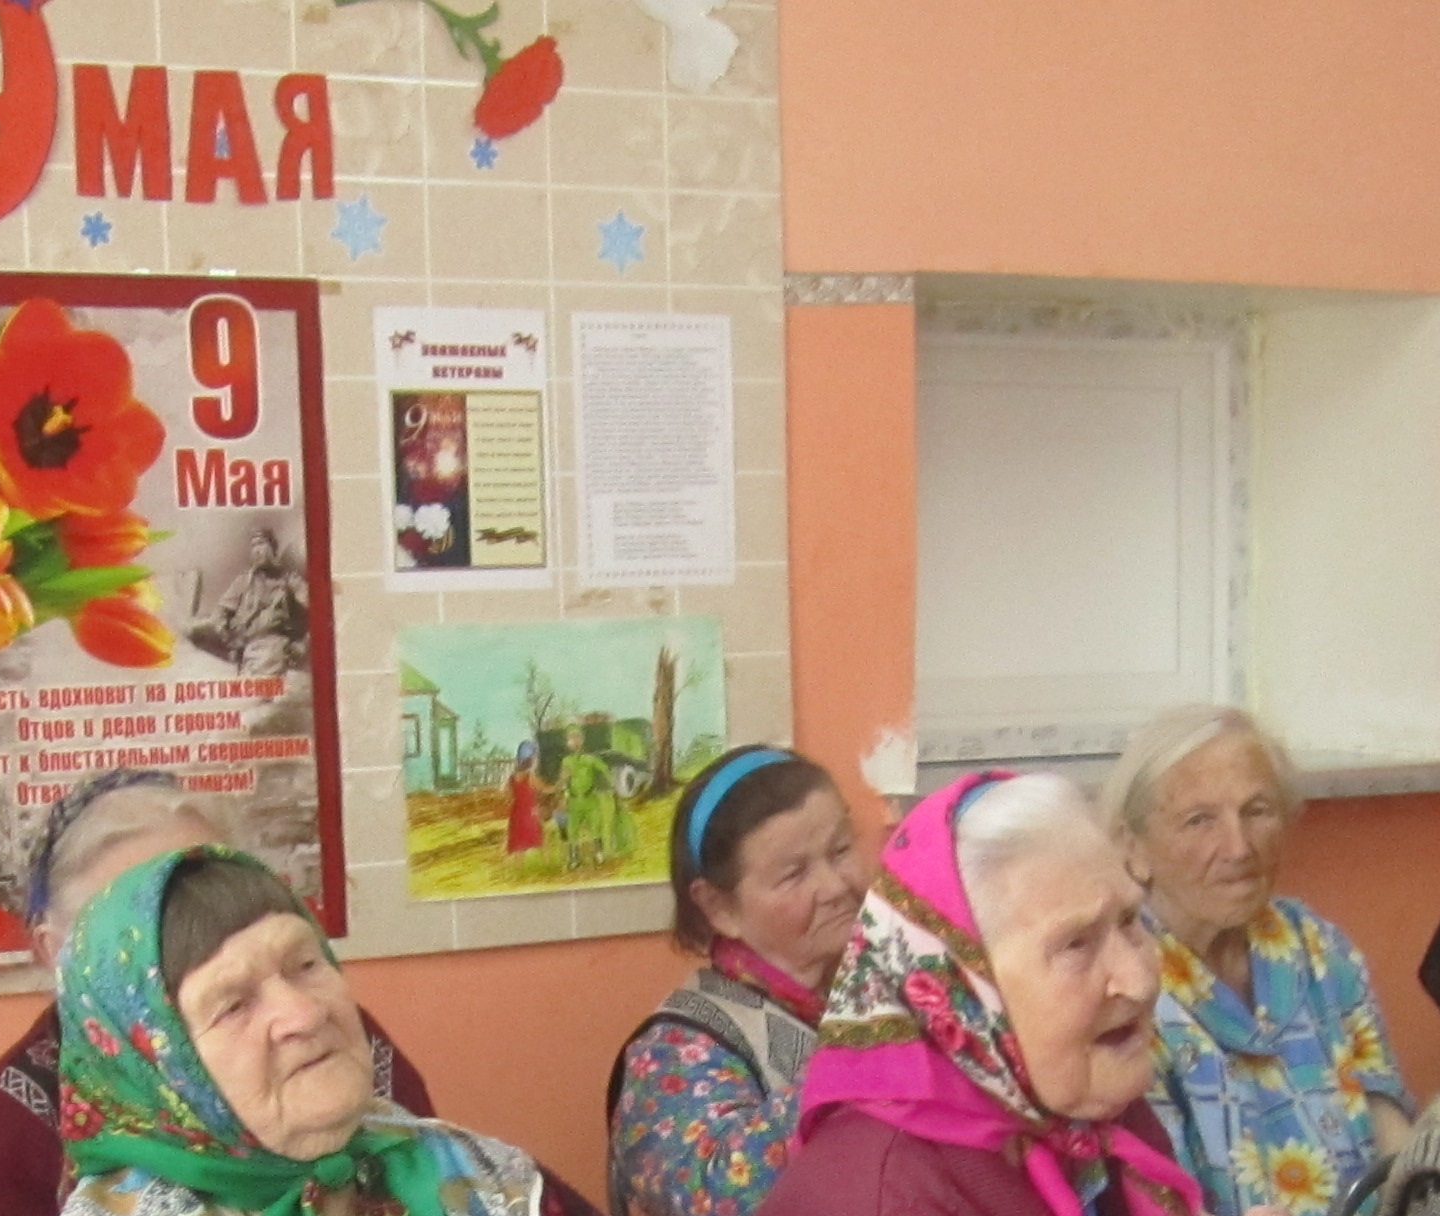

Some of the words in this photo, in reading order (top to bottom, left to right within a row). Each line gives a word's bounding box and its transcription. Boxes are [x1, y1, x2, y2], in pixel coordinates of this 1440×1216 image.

[72, 63, 335, 205] МАЯ
[189, 296, 260, 440] 9
[175, 448, 291, 508] Мая
[39, 684, 136, 710] вдохновит
[145, 683, 166, 703] на
[174, 676, 285, 704] достижения
[18, 717, 75, 742] Отцов
[102, 714, 156, 740] дедов
[20, 754, 30, 773] к
[39, 743, 190, 772] блистательным
[198, 737, 310, 764] свершениям
